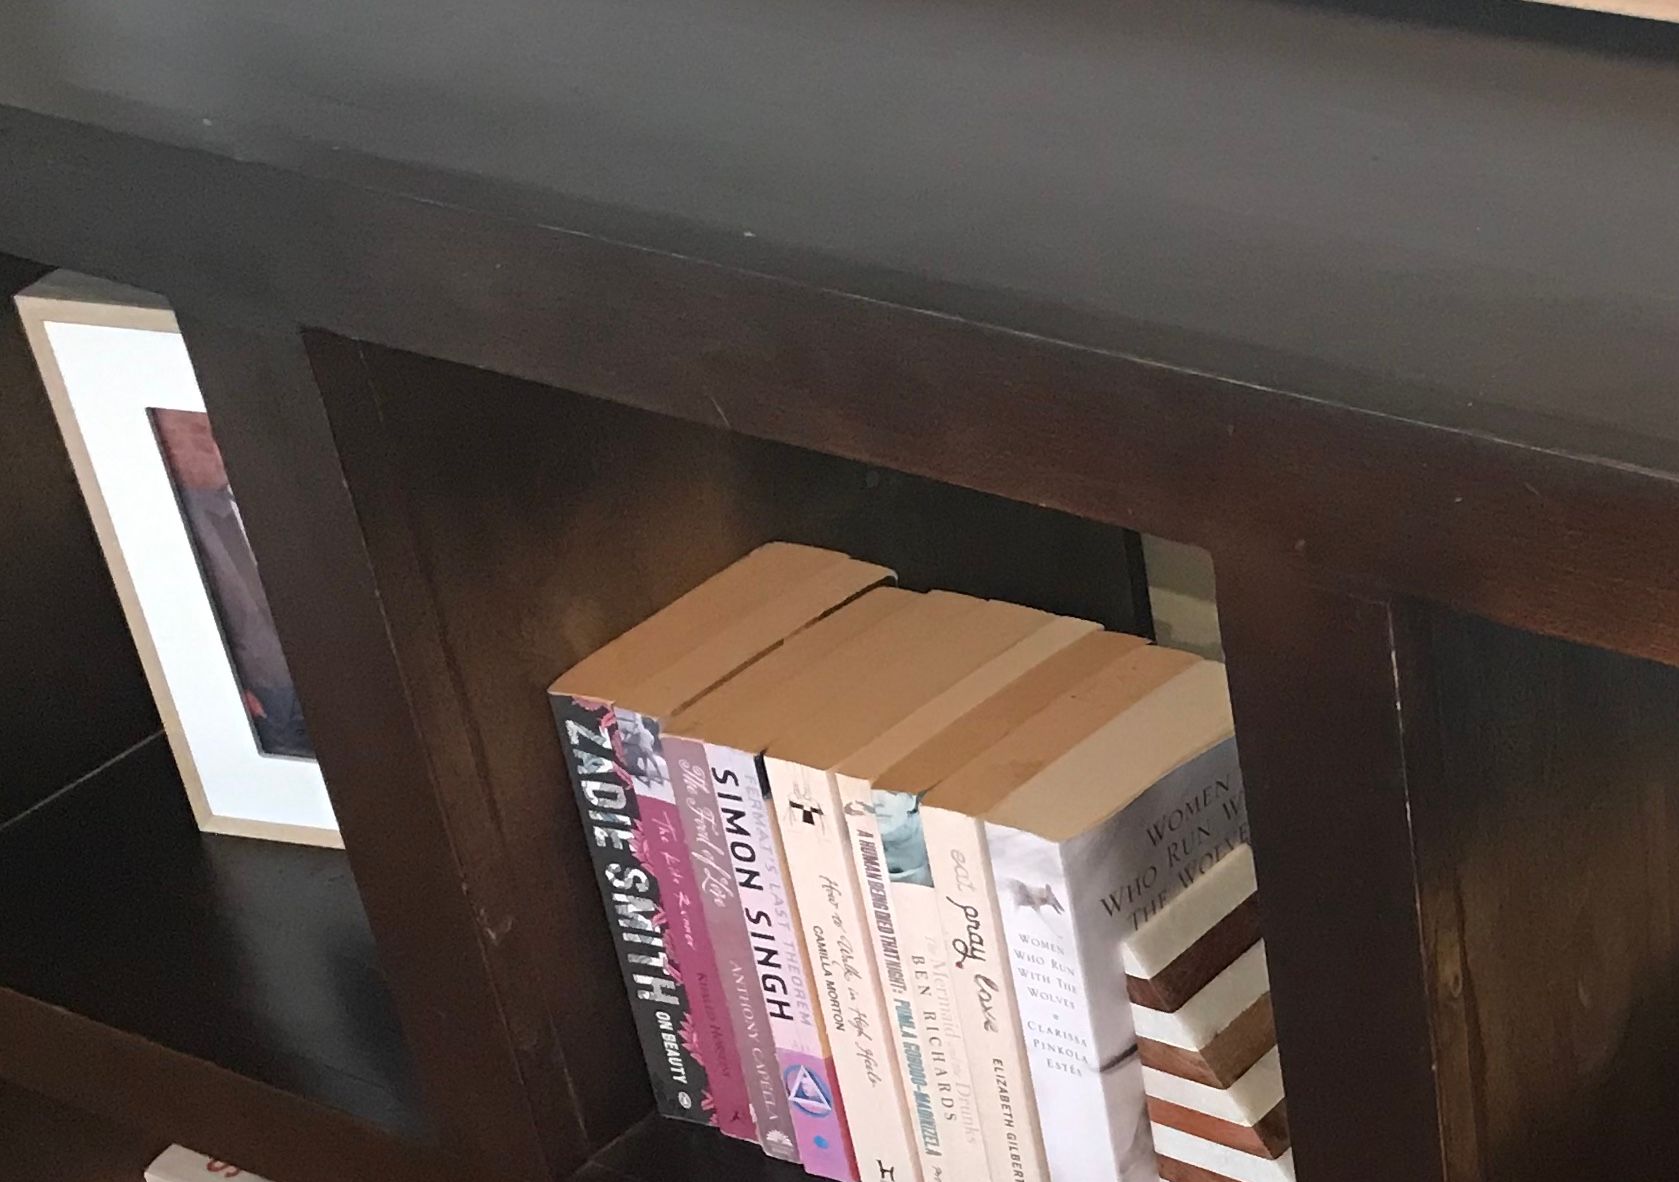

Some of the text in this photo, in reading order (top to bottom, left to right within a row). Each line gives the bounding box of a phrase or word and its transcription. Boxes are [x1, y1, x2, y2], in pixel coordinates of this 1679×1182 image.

[686, 797, 724, 856] Food
[1146, 774, 1230, 847] WOMEN
[565, 719, 680, 1005] ZADIE SMITH
[702, 866, 735, 908] Love
[819, 874, 842, 910] How
[859, 839, 882, 880] HUMAN
[1100, 865, 1158, 917] WHO
[1166, 819, 1211, 868] RUN
[711, 767, 794, 1021] SIMON SINGH
[1129, 890, 1168, 931] THE
[946, 848, 999, 1034] eat pray love
[1013, 948, 1076, 977] WHO RUN
[1018, 933, 1065, 956] WOMEN
[783, 939, 813, 1027] THEOREM
[813, 925, 846, 1032] CAMILLA MORTON
[1017, 966, 1077, 995] WITH THE
[1027, 986, 1076, 1010] WOLVES
[655, 1011, 688, 1084] ON BEAUTY
[729, 960, 760, 1042] ANTHONY
[752, 1047, 778, 1121] CAPELLA
[912, 954, 932, 997] BEN
[923, 1010, 956, 1121] RICHARDS
[1027, 1020, 1088, 1048] CLARISSA
[1033, 1037, 1089, 1065] PINKOLA
[992, 1057, 1015, 1129] ELIZABETH
